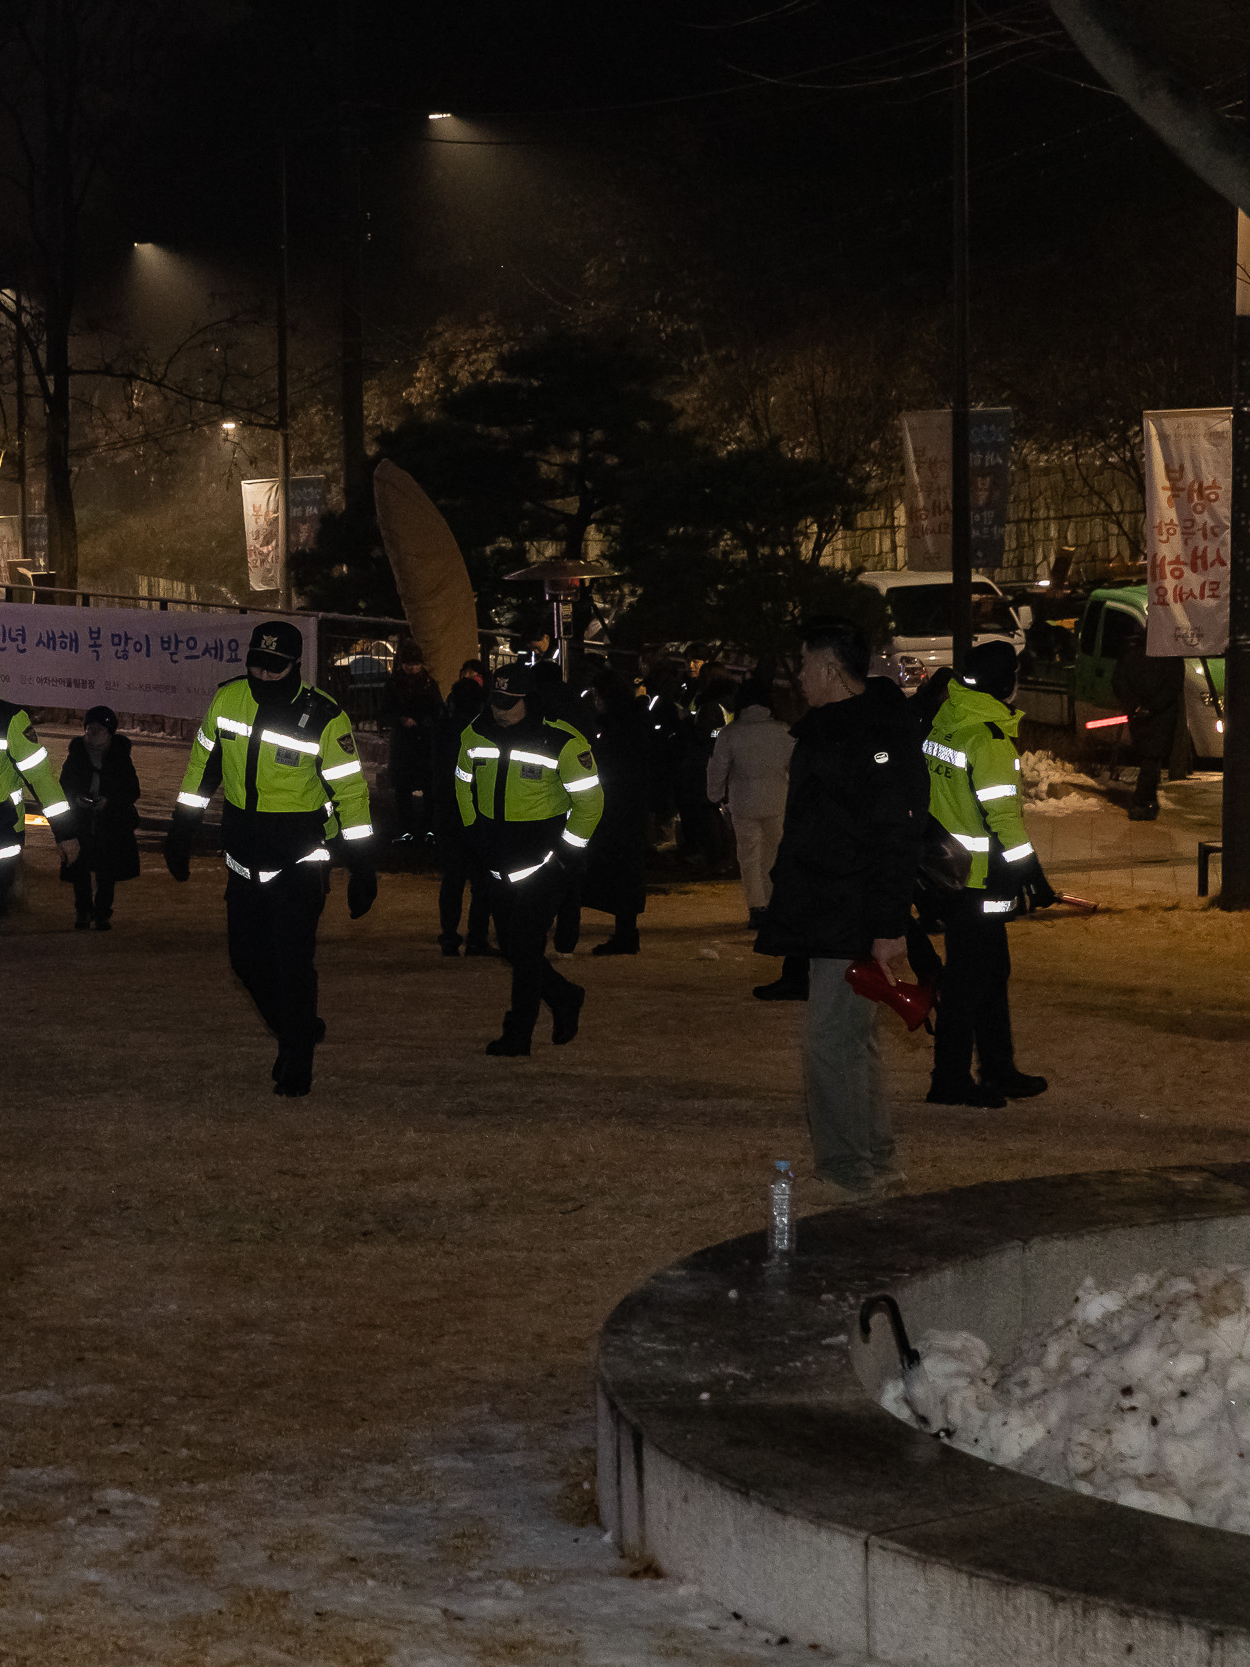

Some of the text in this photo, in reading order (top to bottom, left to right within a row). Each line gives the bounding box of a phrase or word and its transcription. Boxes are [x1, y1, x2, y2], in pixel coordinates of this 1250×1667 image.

[35, 629, 79, 653] 새해
[88, 626, 102, 661] 복
[111, 631, 150, 661] 많이
[160, 632, 242, 664] 받으세요
